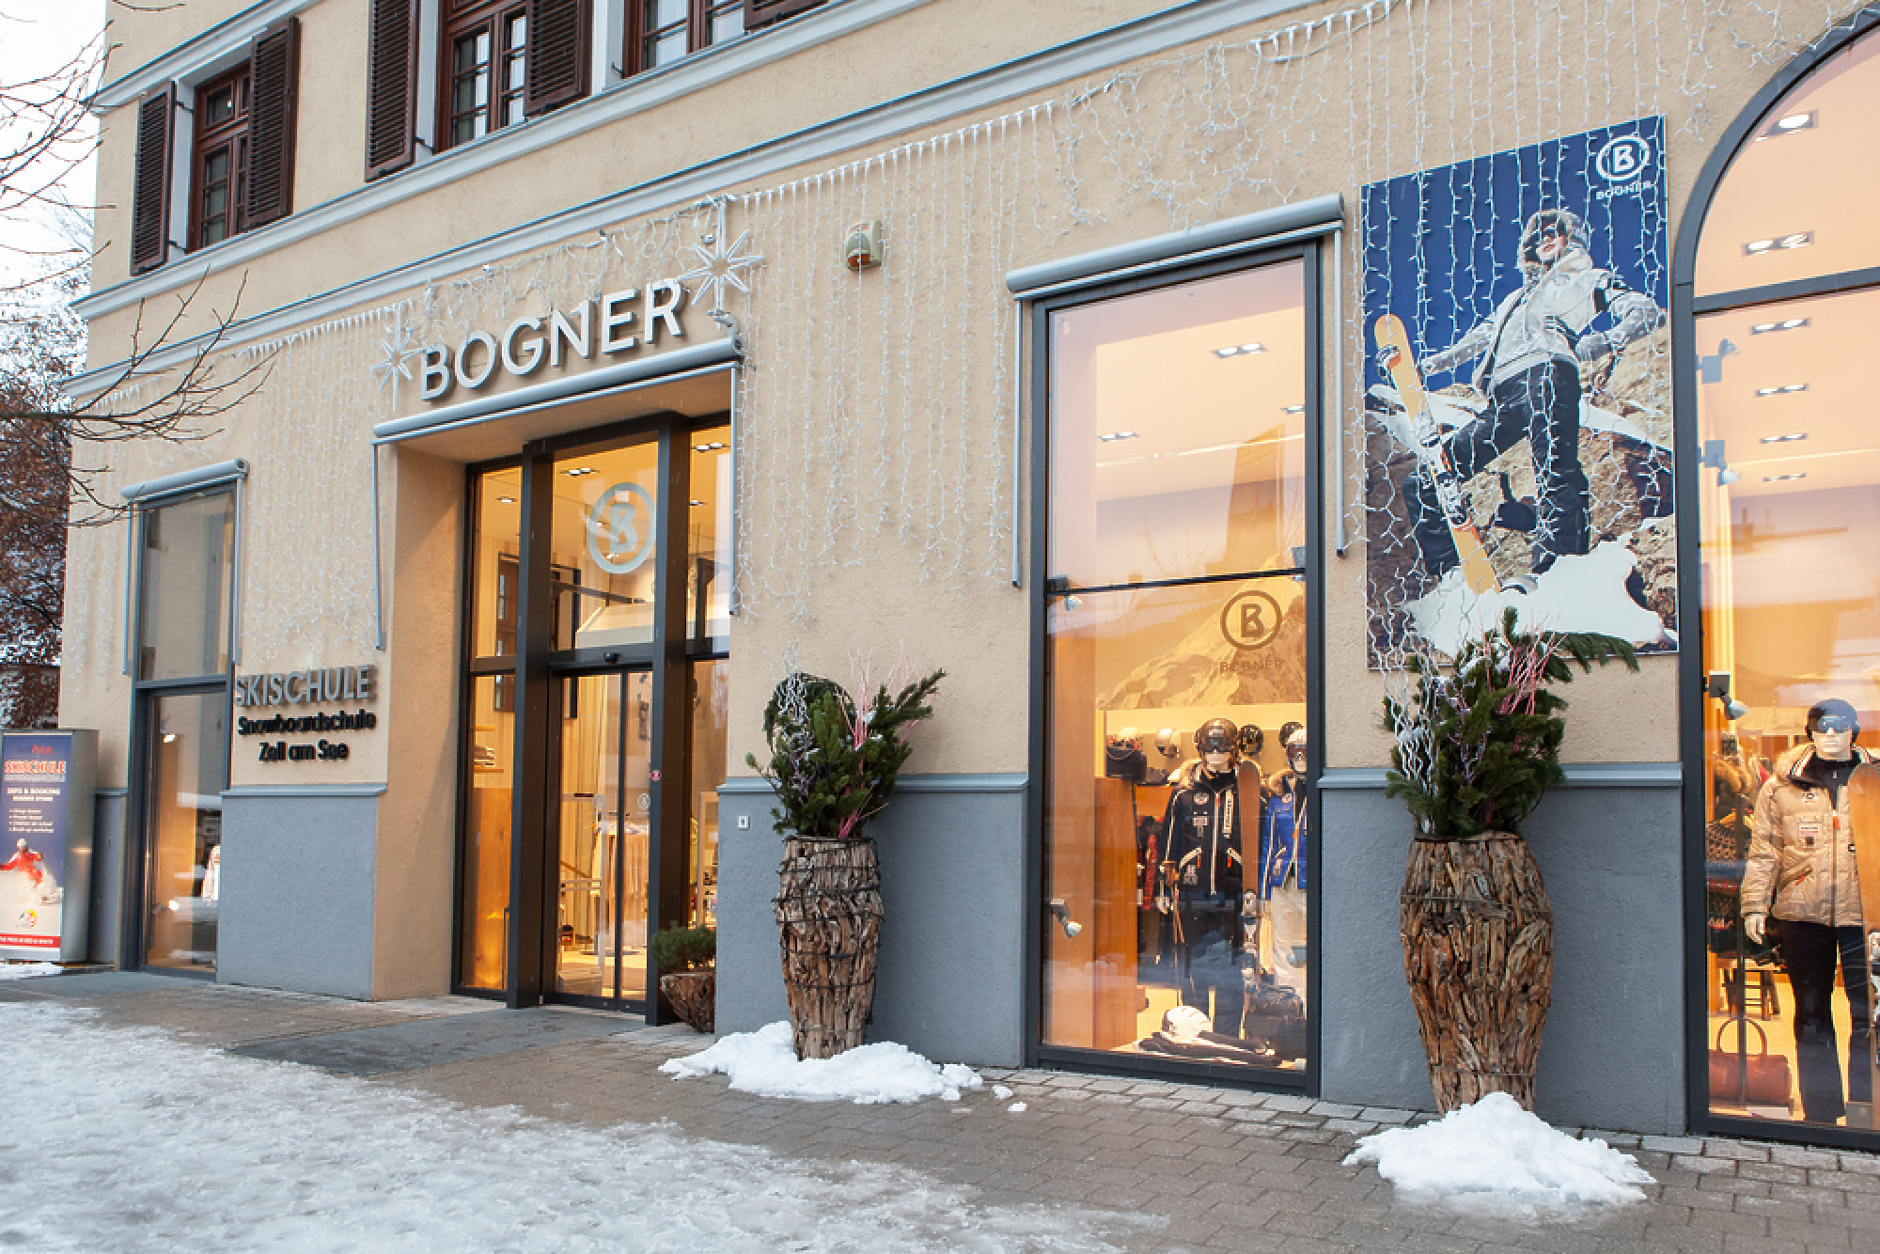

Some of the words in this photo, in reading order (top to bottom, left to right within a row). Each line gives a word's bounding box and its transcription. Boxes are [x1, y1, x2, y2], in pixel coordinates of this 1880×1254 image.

[421, 278, 683, 401] BOGNER
[234, 665, 376, 707] SKISCHULE
[237, 708, 377, 736] Snowboardschule
[258, 741, 287, 762] Zell
[288, 744, 316, 761] am
[317, 739, 350, 761] See
[4, 760, 66, 774] SKISCHULE
